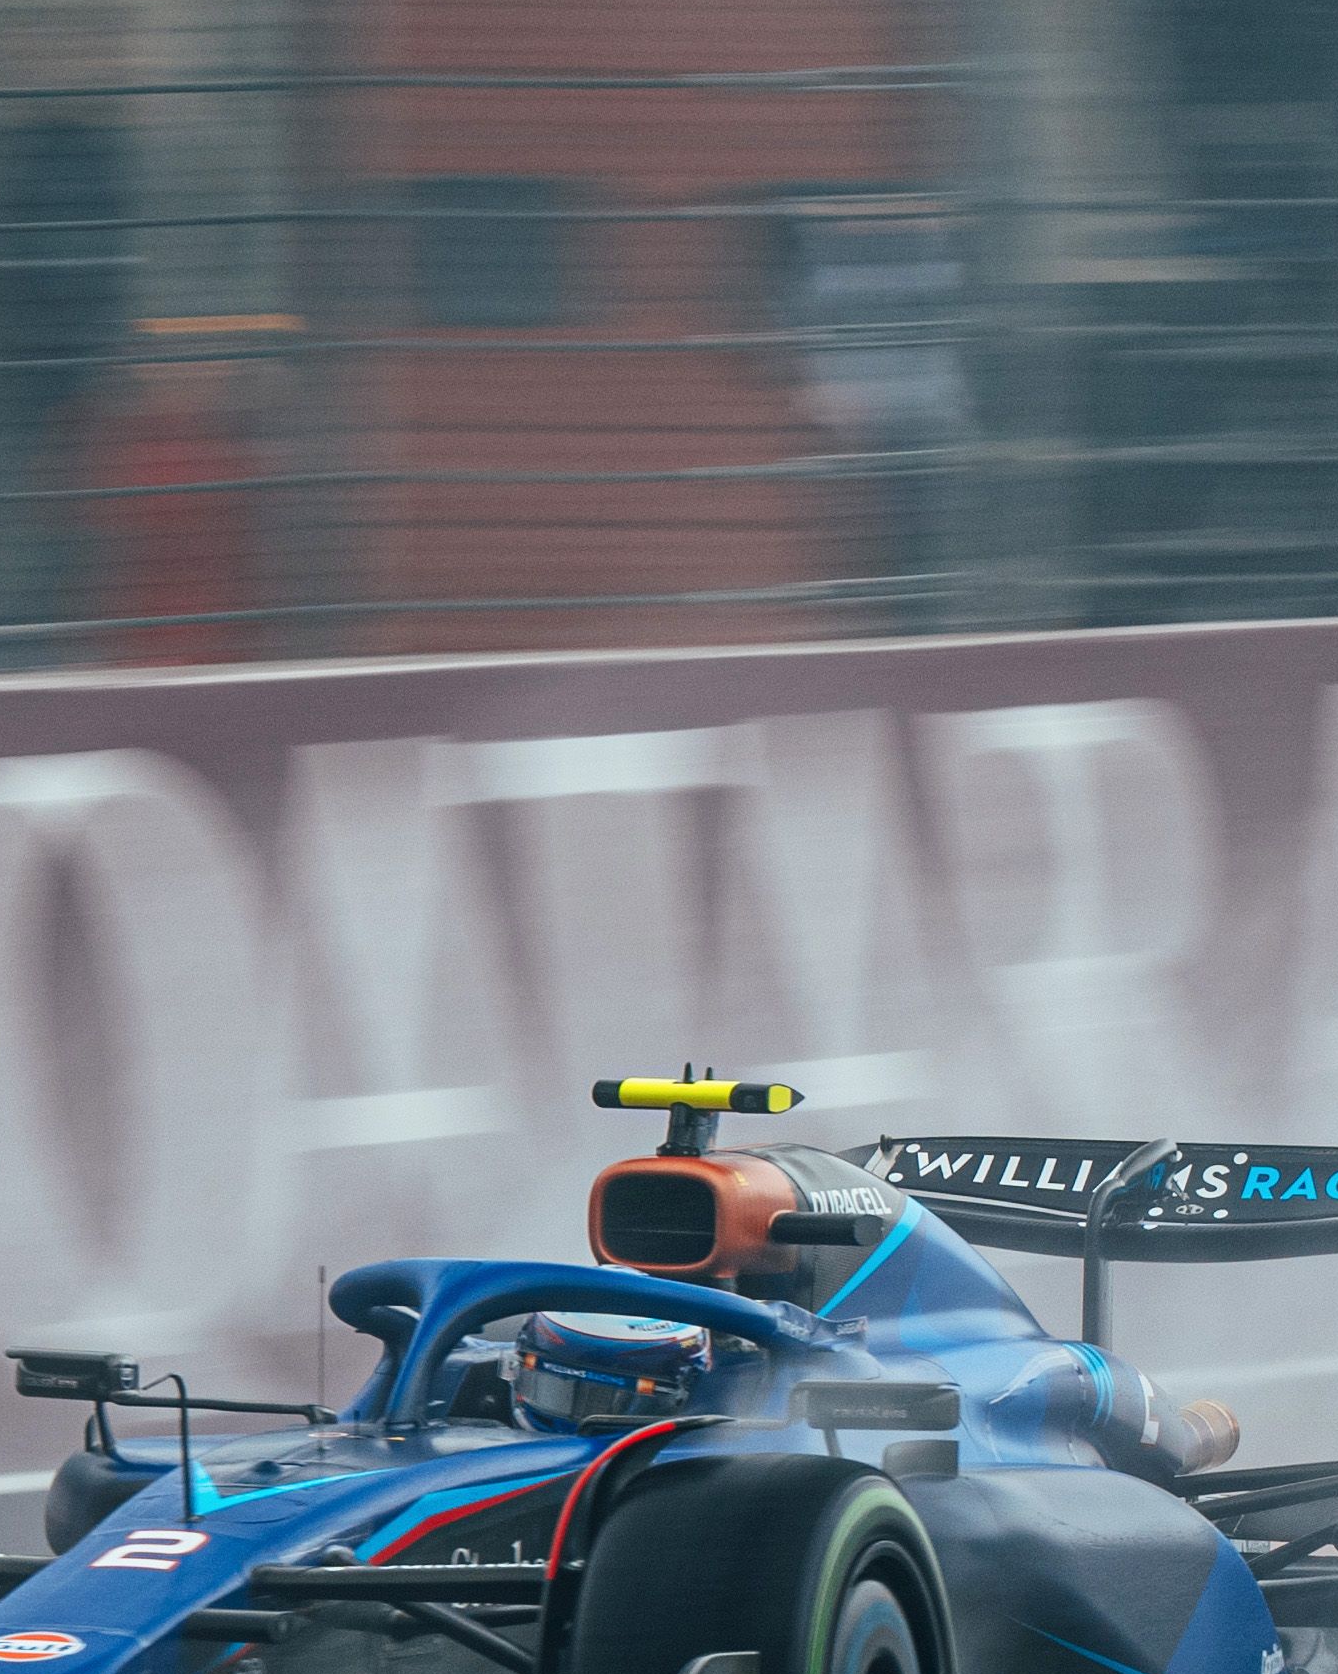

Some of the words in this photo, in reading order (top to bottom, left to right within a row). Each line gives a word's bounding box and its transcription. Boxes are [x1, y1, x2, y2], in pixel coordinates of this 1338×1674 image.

[916, 1151, 1230, 1200] WILLIS
[809, 1187, 893, 1215] DURACELL
[88, 1528, 210, 1572] 2
